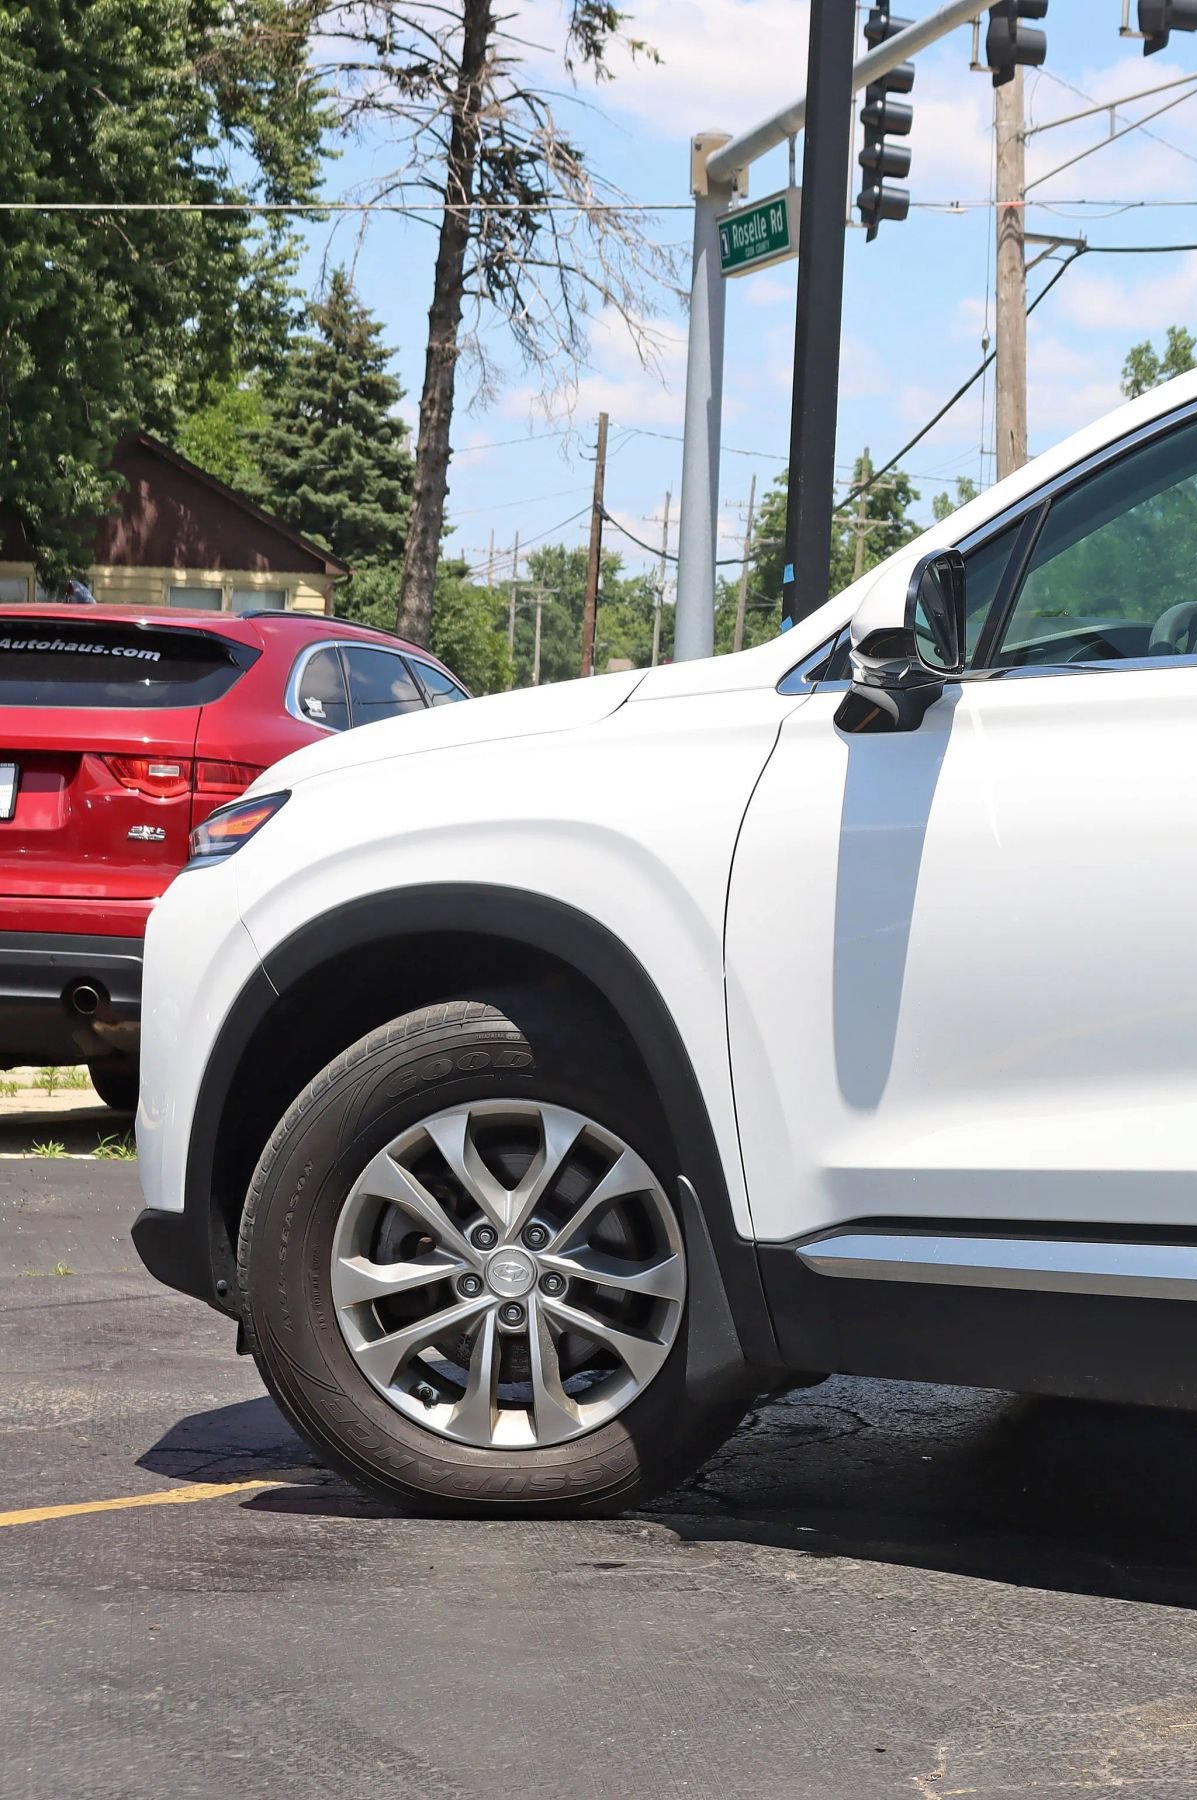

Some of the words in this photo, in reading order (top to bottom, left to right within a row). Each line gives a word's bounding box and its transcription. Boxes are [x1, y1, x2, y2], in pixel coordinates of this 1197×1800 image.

[732, 212, 767, 249] Roselle
[769, 203, 783, 235] Rd
[0, 638, 161, 661] Autohaus.com
[320, 1397, 637, 1493] ASSURANCE
